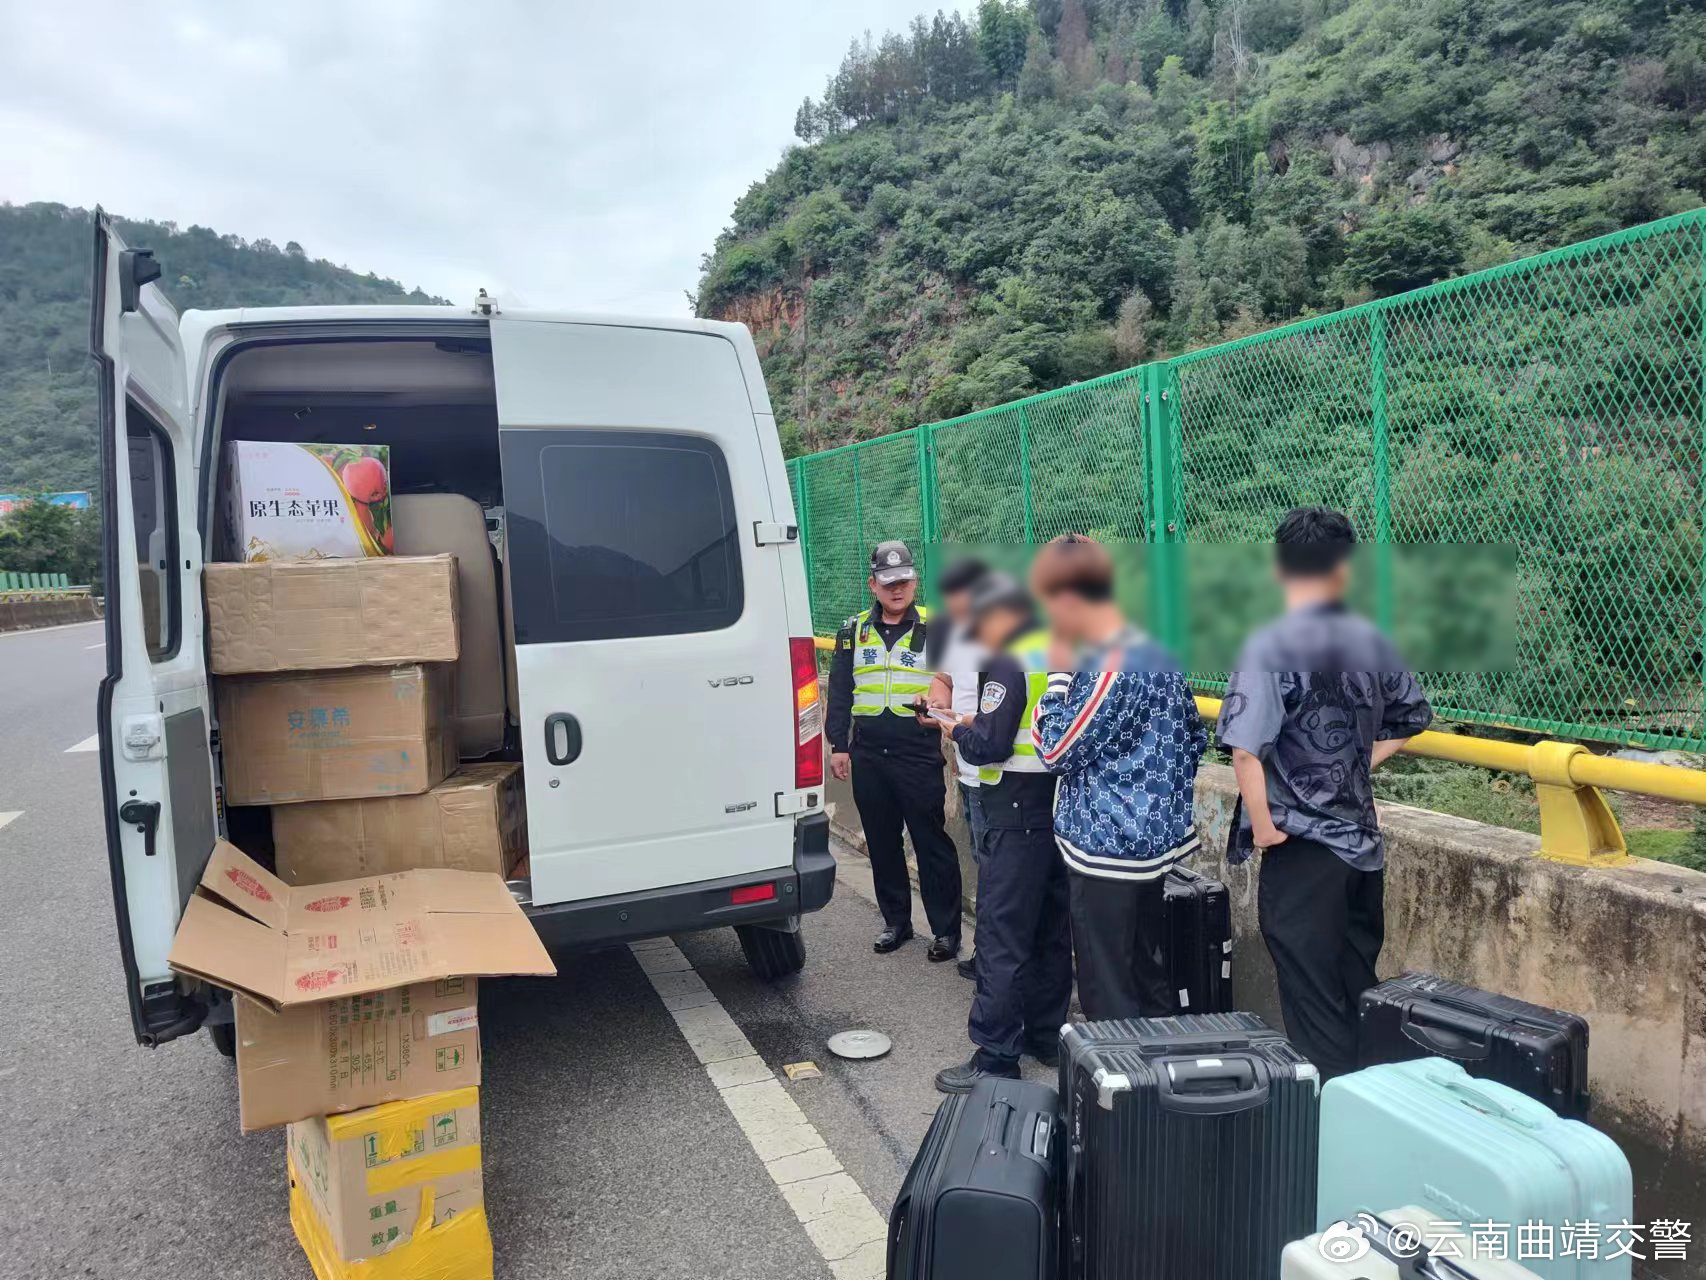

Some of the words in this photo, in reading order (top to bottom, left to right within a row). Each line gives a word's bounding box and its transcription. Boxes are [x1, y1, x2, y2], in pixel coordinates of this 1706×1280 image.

[249, 499, 340, 518] 原生态苹果
[708, 675, 754, 688] V80
[724, 801, 757, 814] ESP
[371, 1226, 399, 1247] 数量
